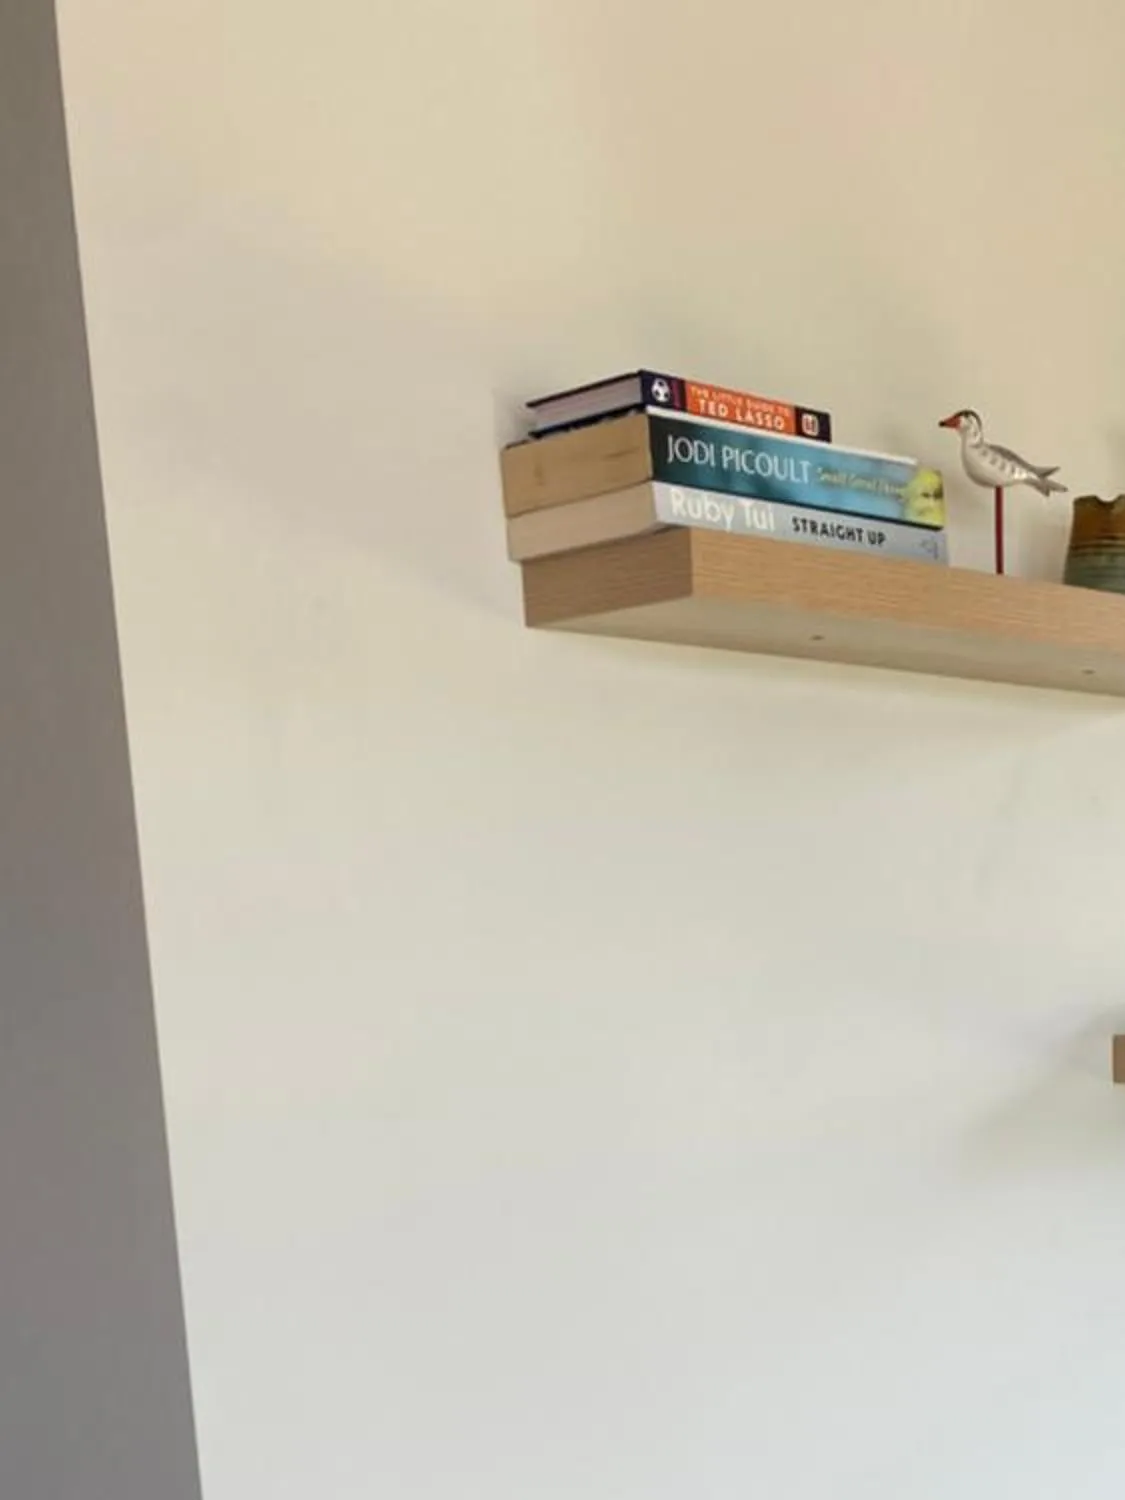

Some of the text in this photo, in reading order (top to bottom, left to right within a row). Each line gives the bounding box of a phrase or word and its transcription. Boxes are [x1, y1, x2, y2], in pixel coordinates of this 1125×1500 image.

[699, 398, 729, 417] TED
[735, 407, 785, 431] LASSO
[667, 434, 811, 483] JODI PICOULT
[670, 488, 775, 533] Ruby Tui
[791, 516, 887, 545] STRAIGHT UP
